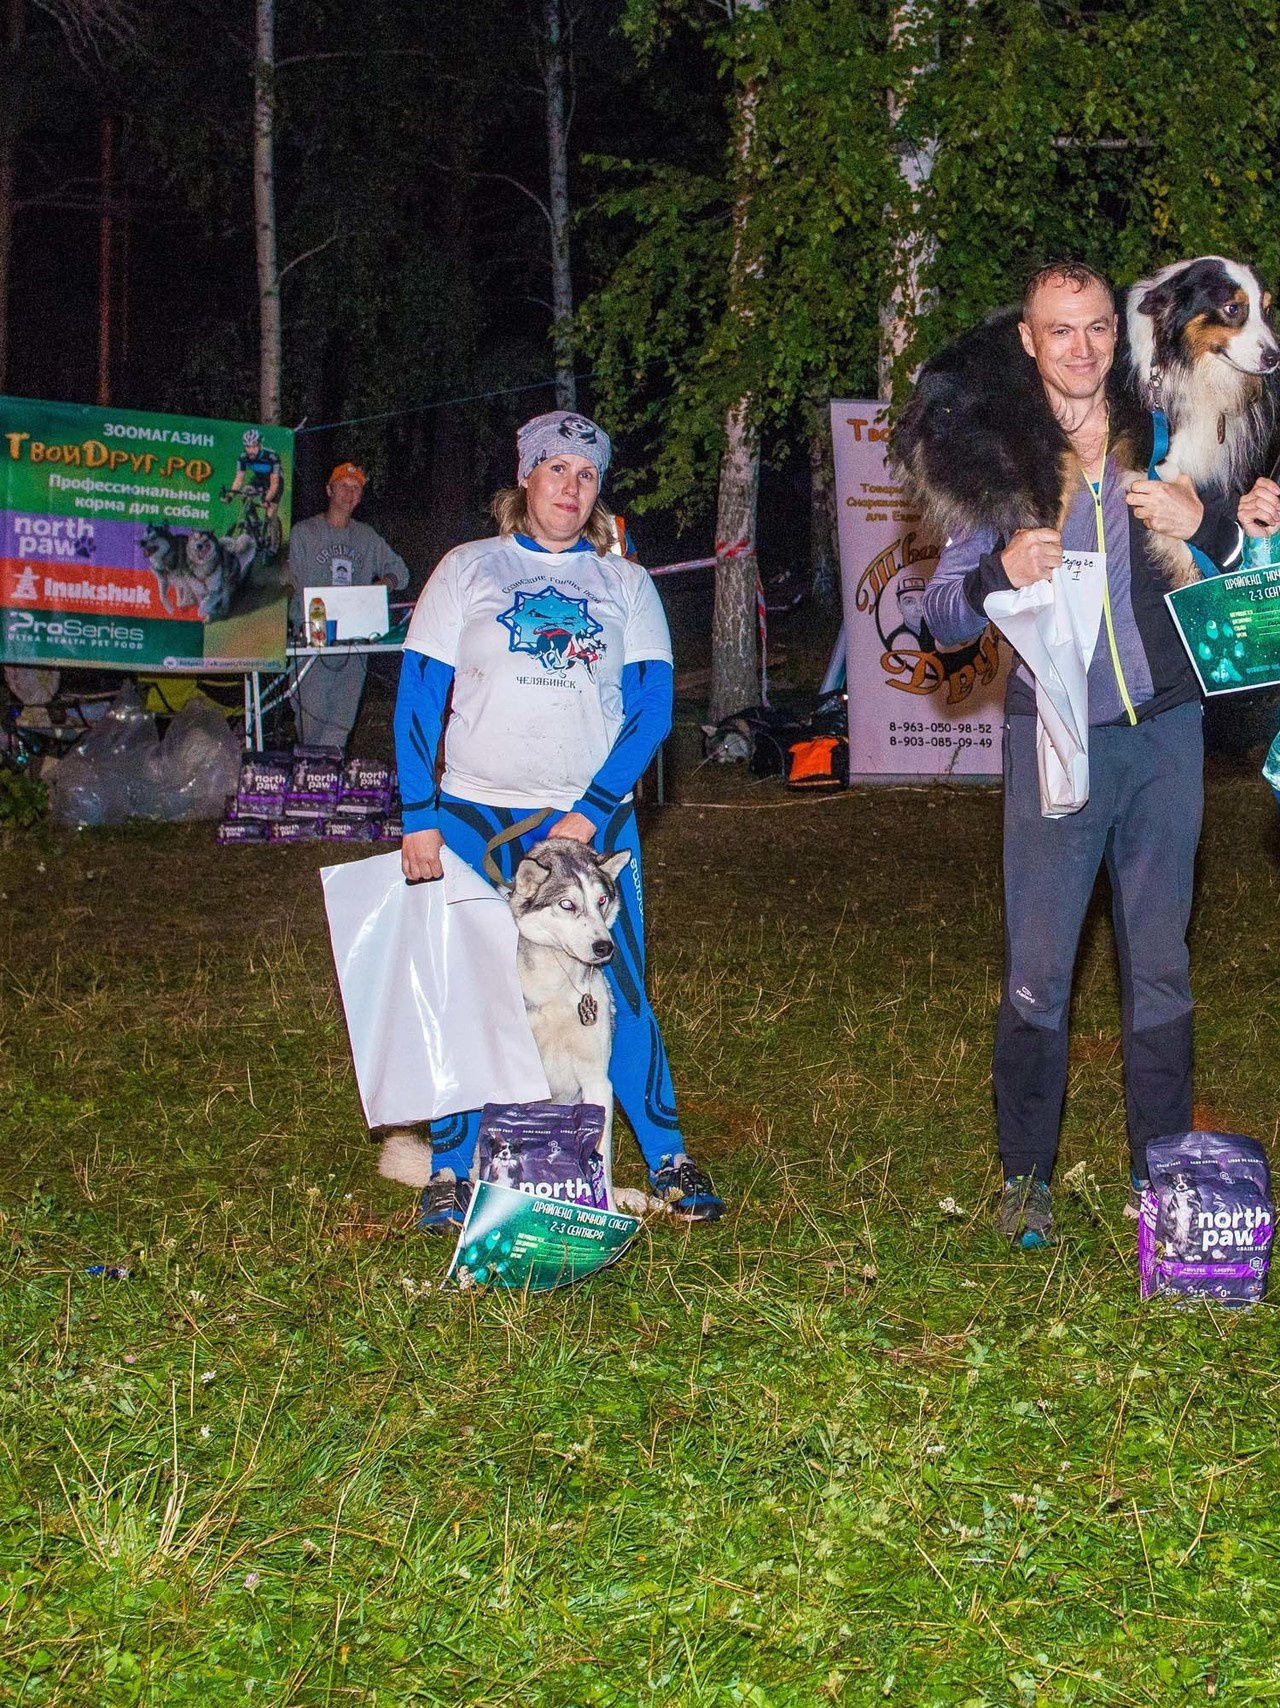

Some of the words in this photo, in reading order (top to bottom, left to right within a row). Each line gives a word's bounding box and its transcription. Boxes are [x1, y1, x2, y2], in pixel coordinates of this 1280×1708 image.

[103, 423, 214, 447] ЗООМАГАЗИН
[49, 474, 211, 502] Профессиональные
[75, 497, 125, 512] корма
[129, 502, 159, 515] для
[164, 505, 210, 519] собак
[14, 517, 94, 538] north
[19, 536, 76, 558] paw
[44, 577, 151, 604] Inukshuk
[1249, 590, 1264, 602] 2-3
[8, 611, 144, 641] ProSeries
[8, 634, 41, 643] ULTRA
[47, 636, 86, 645] HEALTH
[91, 638, 110, 647] PET
[115, 641, 144, 650] FOOD
[516, 676, 577, 689] ЧЕЛЯБИНСК
[889, 722, 992, 734] 8-963-050-98-52
[890, 736, 993, 748] 8-903-085-09-49
[255, 775, 286, 784] north
[307, 773, 338, 782] north
[360, 771, 388, 780] north
[360, 778, 381, 787] paw
[256, 782, 278, 791] paw
[308, 781, 331, 790] paw
[520, 1178, 592, 1199] north
[1198, 1206, 1271, 1229] north
[550, 1221, 566, 1234] 2-3
[566, 1225, 605, 1241] СЕНТЯБРЯ
[1202, 1227, 1254, 1252] paw
